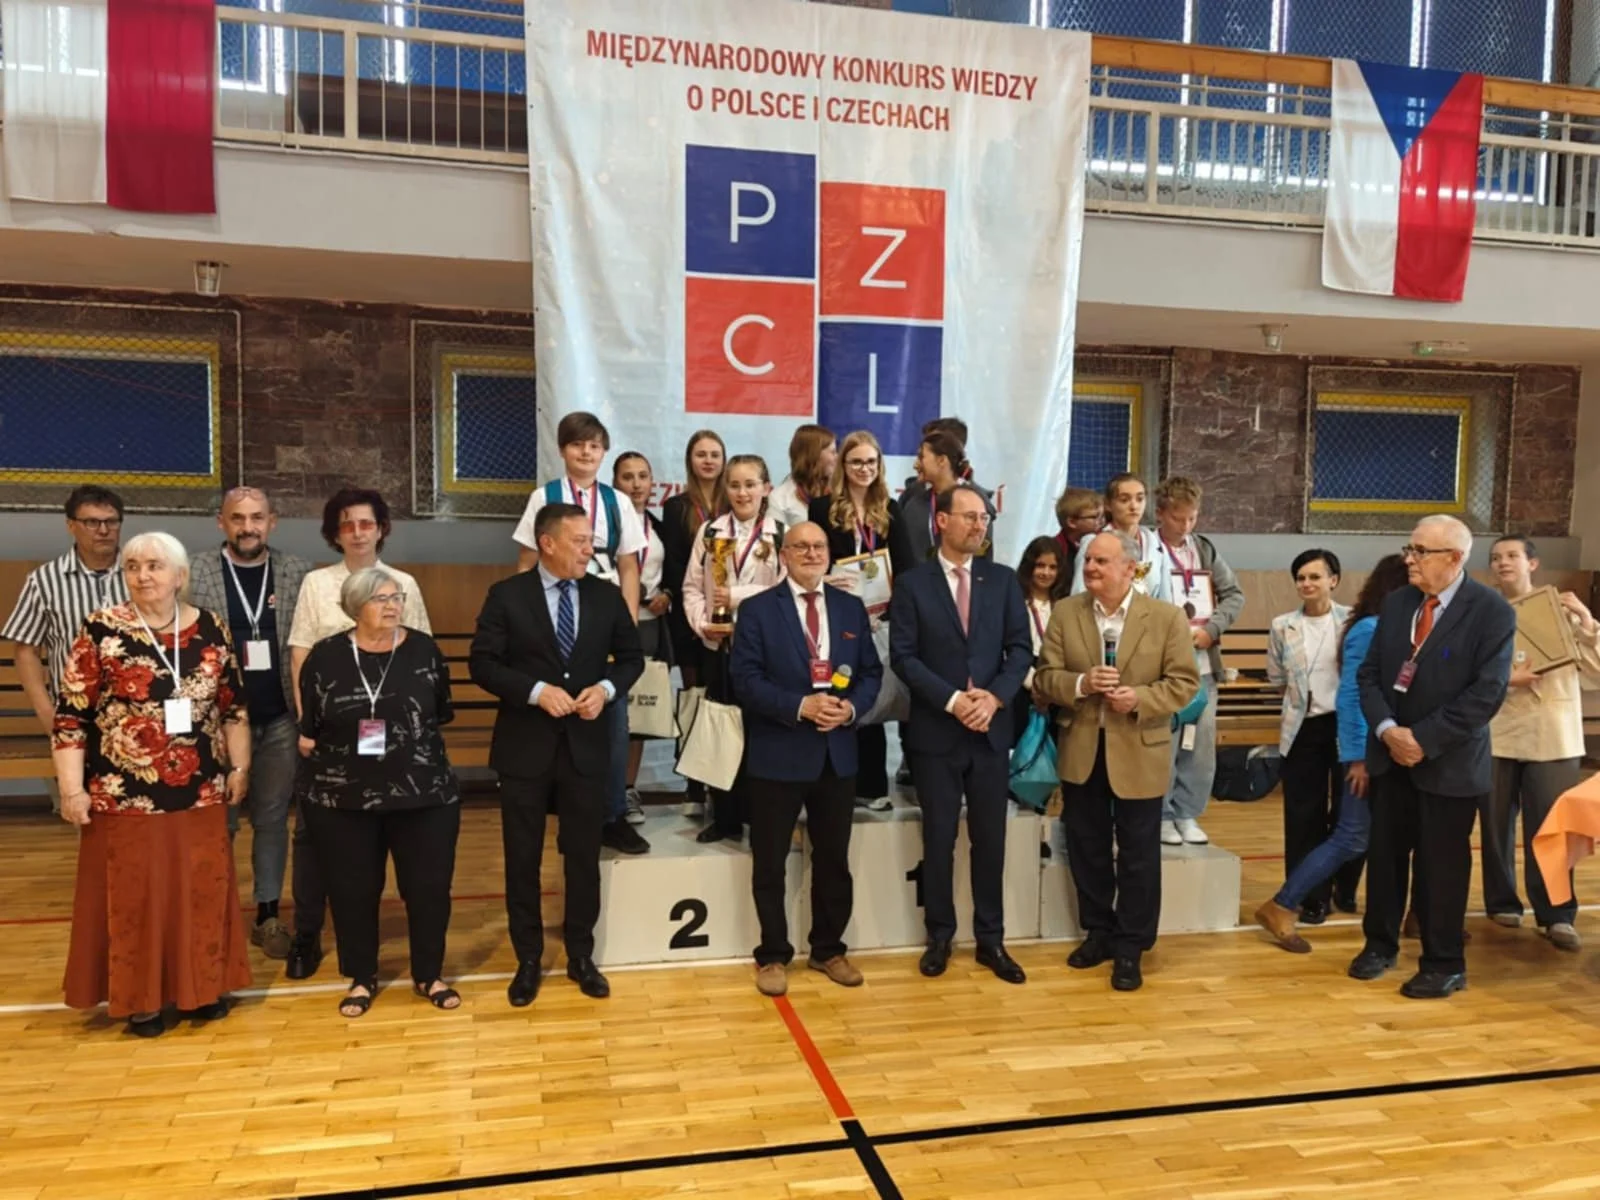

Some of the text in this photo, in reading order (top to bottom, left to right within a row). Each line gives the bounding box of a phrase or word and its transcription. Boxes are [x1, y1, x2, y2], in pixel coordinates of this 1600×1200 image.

[586, 29, 1038, 101] MIĘDZYNARODOWY KONKURS WIEDZY
[687, 84, 951, 131] O POLSCE I CZECHACH
[730, 181, 776, 243] P
[860, 226, 907, 289] Z
[722, 313, 776, 376] C
[868, 352, 900, 414] L
[669, 898, 709, 949] 2
